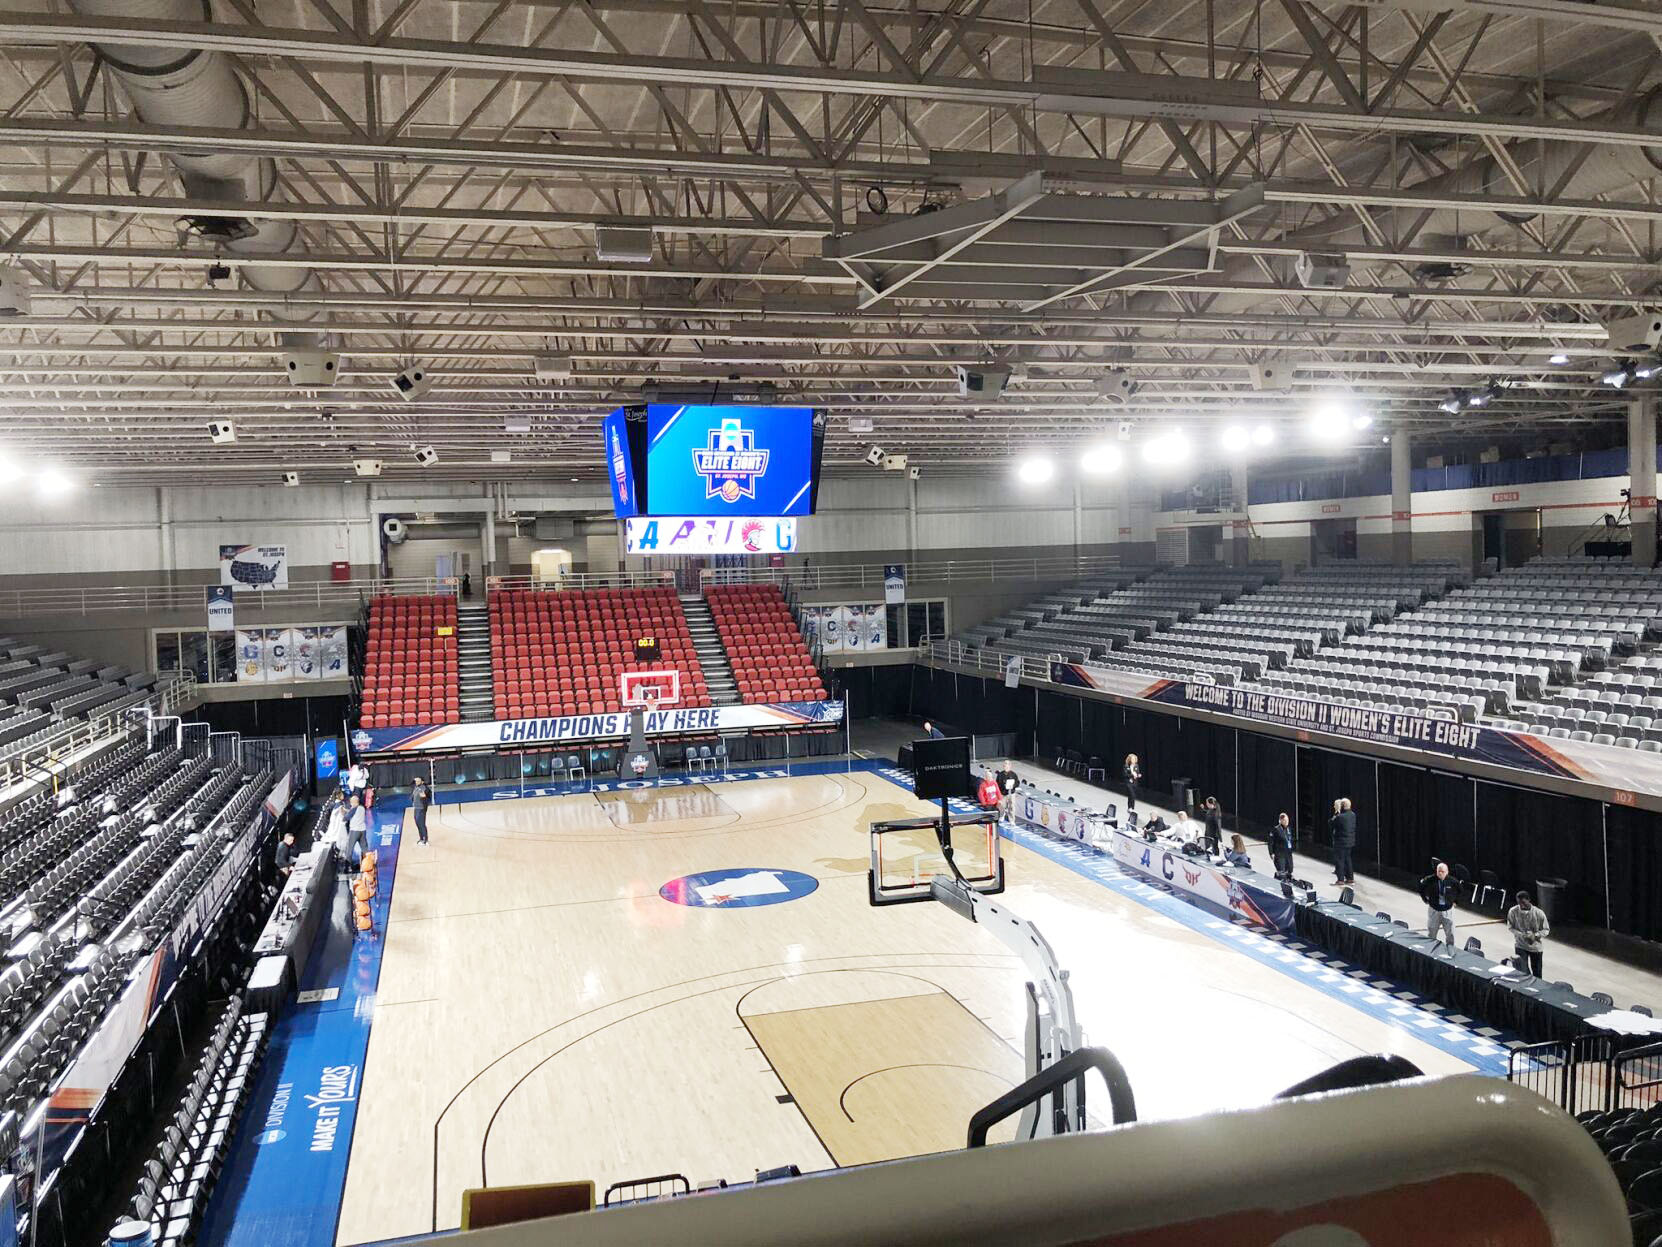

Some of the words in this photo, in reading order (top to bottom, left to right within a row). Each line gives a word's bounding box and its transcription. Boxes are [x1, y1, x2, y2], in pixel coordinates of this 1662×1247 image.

[701, 455, 731, 470] ELITE
[731, 456, 763, 471] EIGHT
[209, 607, 232, 615] UNITED
[500, 715, 617, 742] CHAMPIONS
[624, 710, 670, 733] PAY
[674, 708, 720, 730] HERE
[1185, 683, 1229, 706] WELCOME
[1231, 690, 1244, 709] TO
[1246, 693, 1265, 713] THE
[1267, 696, 1316, 722] DIVISION
[1318, 704, 1327, 723] II
[1330, 705, 1391, 734] WOMEN'S
[1394, 715, 1432, 741] ELITE
[1434, 721, 1481, 749] EIGHT
[1268, 714, 1285, 723] WESTERN
[1286, 717, 1296, 725] STATE
[1297, 719, 1320, 729] UNIVERSITY
[1320, 723, 1328, 731] AND
[1336, 726, 1352, 735] JOSEPH
[1353, 729, 1369, 738] SPORTS
[1370, 732, 1400, 743] COMMISSION
[492, 786, 571, 799] ST.
[590, 769, 789, 792] JOSEPH
[1615, 791, 1633, 801] 107
[304, 1065, 356, 1108] YOURS
[266, 1088, 292, 1127] DIVISION
[319, 1105, 341, 1117] IT
[310, 1117, 339, 1152] MAKE
